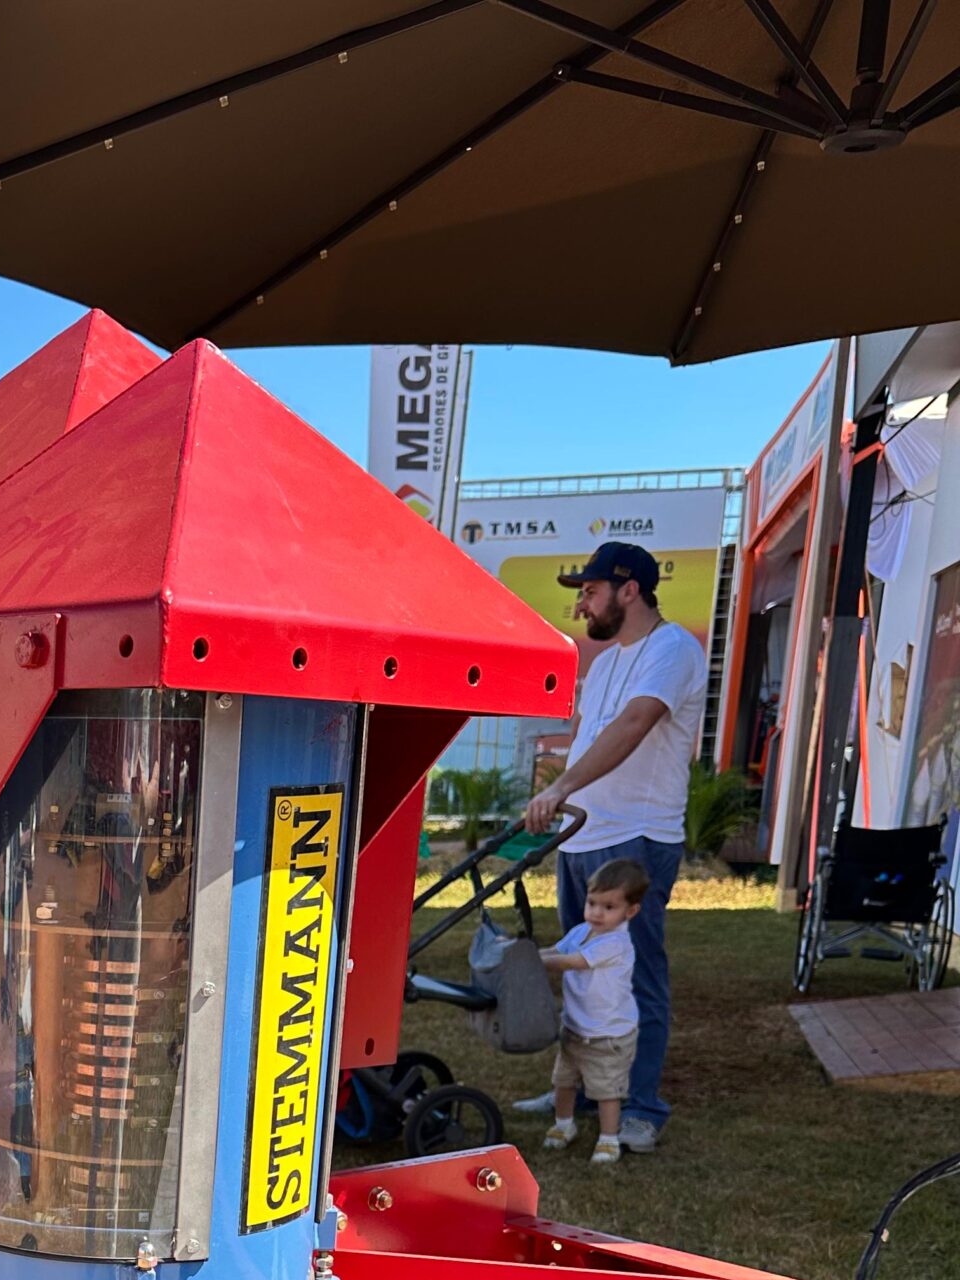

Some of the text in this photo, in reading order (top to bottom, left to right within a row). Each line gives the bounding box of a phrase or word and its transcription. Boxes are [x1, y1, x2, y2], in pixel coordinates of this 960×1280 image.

[436, 366, 448, 384] DE
[432, 390, 448, 472] SECADORES
[490, 521, 556, 536] TMSA
[609, 518, 654, 531] MEGA
[266, 806, 332, 1210] STEMMANN
